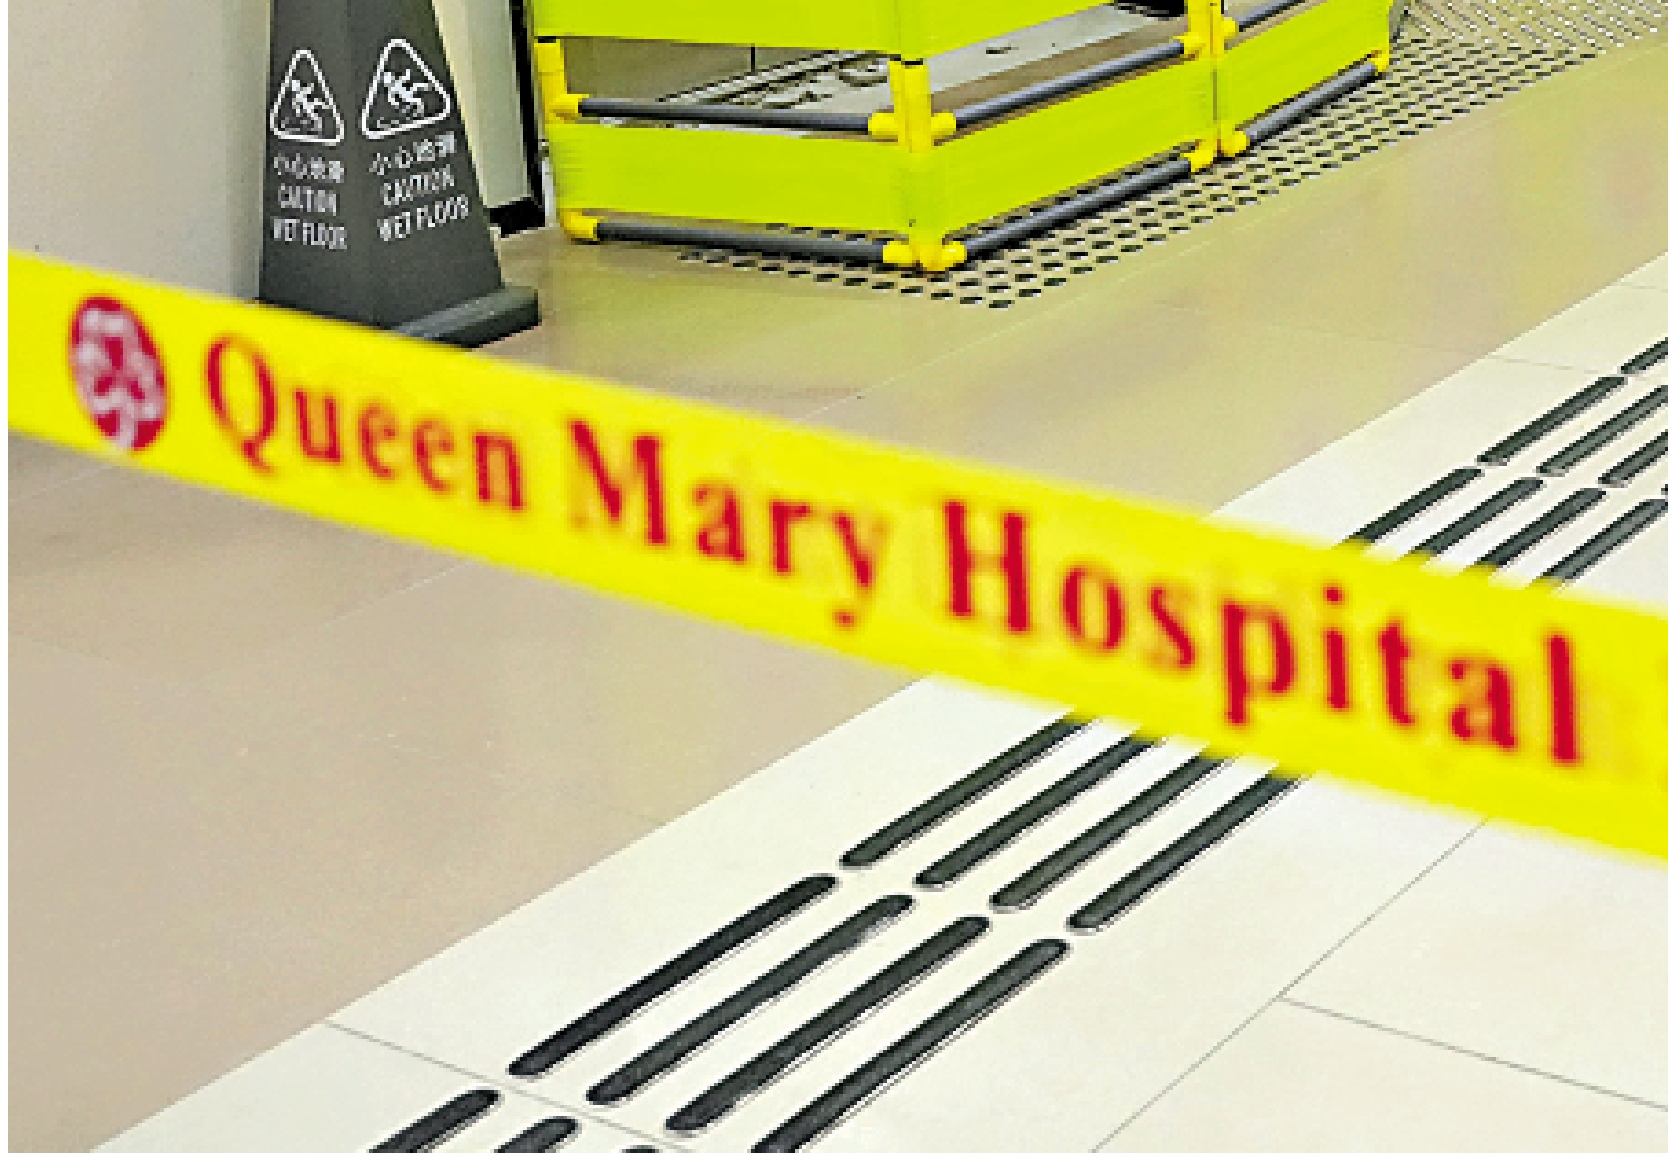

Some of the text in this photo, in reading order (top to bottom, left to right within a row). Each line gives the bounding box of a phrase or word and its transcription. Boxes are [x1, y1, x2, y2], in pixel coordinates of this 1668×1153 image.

[278, 183, 336, 215] CAUTION
[382, 165, 456, 207] CAUTION
[274, 216, 347, 249] WET FLOOR
[377, 194, 468, 241] WET FLOOR
[204, 333, 527, 517] Queen
[567, 417, 890, 627] Mary
[938, 497, 1581, 767] Hospital
